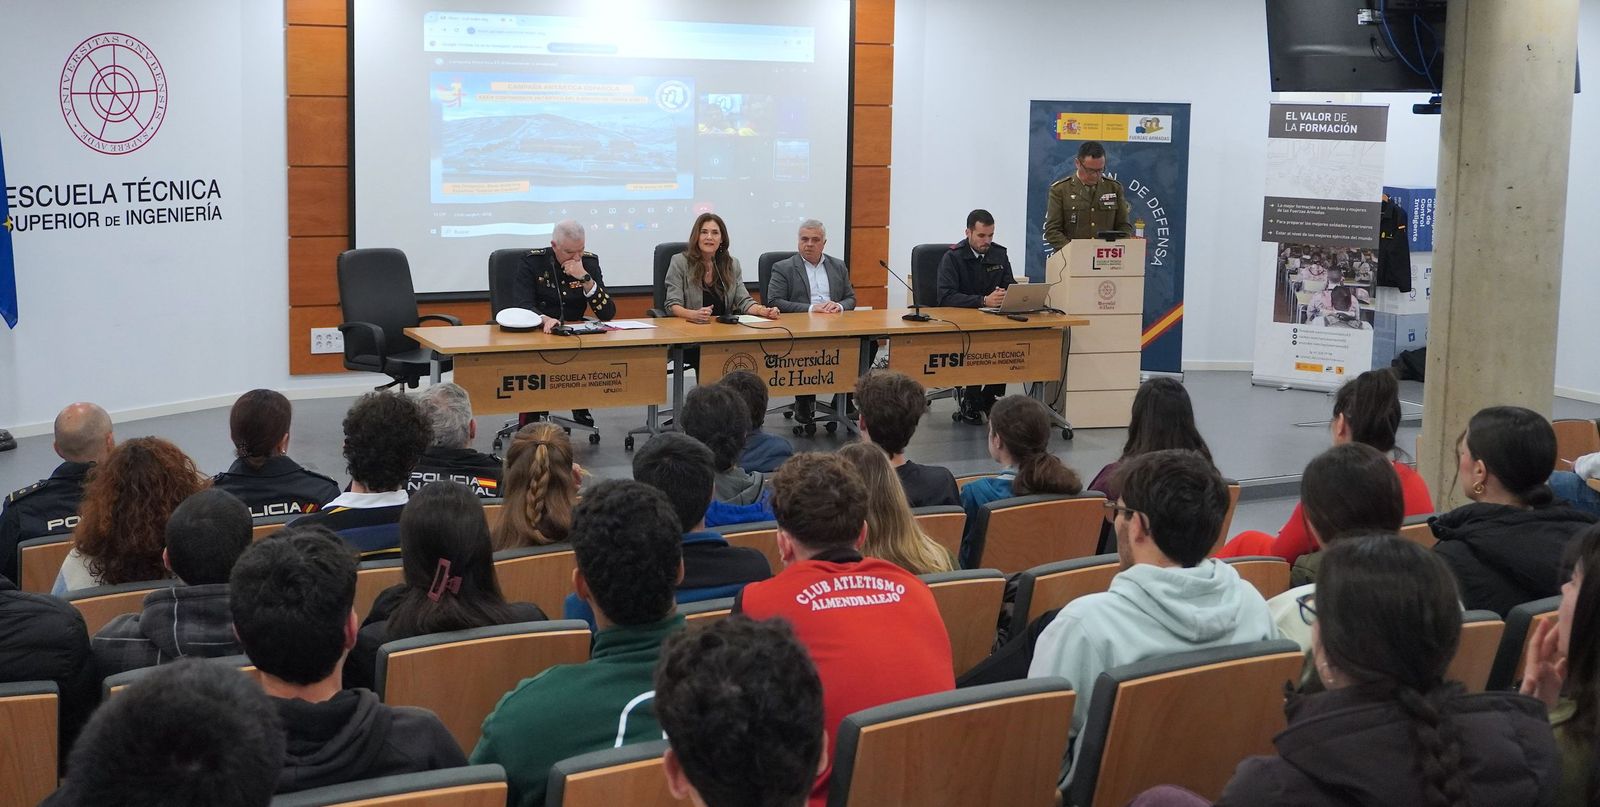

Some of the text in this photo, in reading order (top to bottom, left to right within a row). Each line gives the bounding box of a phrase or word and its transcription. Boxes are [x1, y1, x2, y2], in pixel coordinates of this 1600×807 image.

[62, 36, 165, 120] VNIVERSITAS ONVBENSIS
[1285, 111, 1348, 122] EL VALOR DE
[1285, 122, 1358, 134] LA FORMACIÓN
[80, 131, 149, 152] SAPERE AVDE
[6, 176, 221, 208] ESCUELA TÉCNICA
[105, 215, 120, 227] DE
[126, 202, 222, 226] INGENIERÍA
[1128, 179, 1170, 266] DE DEFENSA
[1412, 198, 1420, 242] Inteligente
[1097, 248, 1122, 258] ETSI
[764, 349, 840, 369] Universidad
[929, 351, 1025, 368] ETSI ESCUELA TÉCNICA
[503, 371, 622, 391] ETSI ESCUELA TÉCNICA
[549, 382, 580, 390] SUPERIOR
[769, 369, 834, 387] de Huelva
[409, 472, 480, 486] POLICIA
[248, 501, 302, 517] LICIA
[795, 575, 906, 605] CLUB ATLETISMO
[811, 592, 901, 611] ALMENDRALEJO
